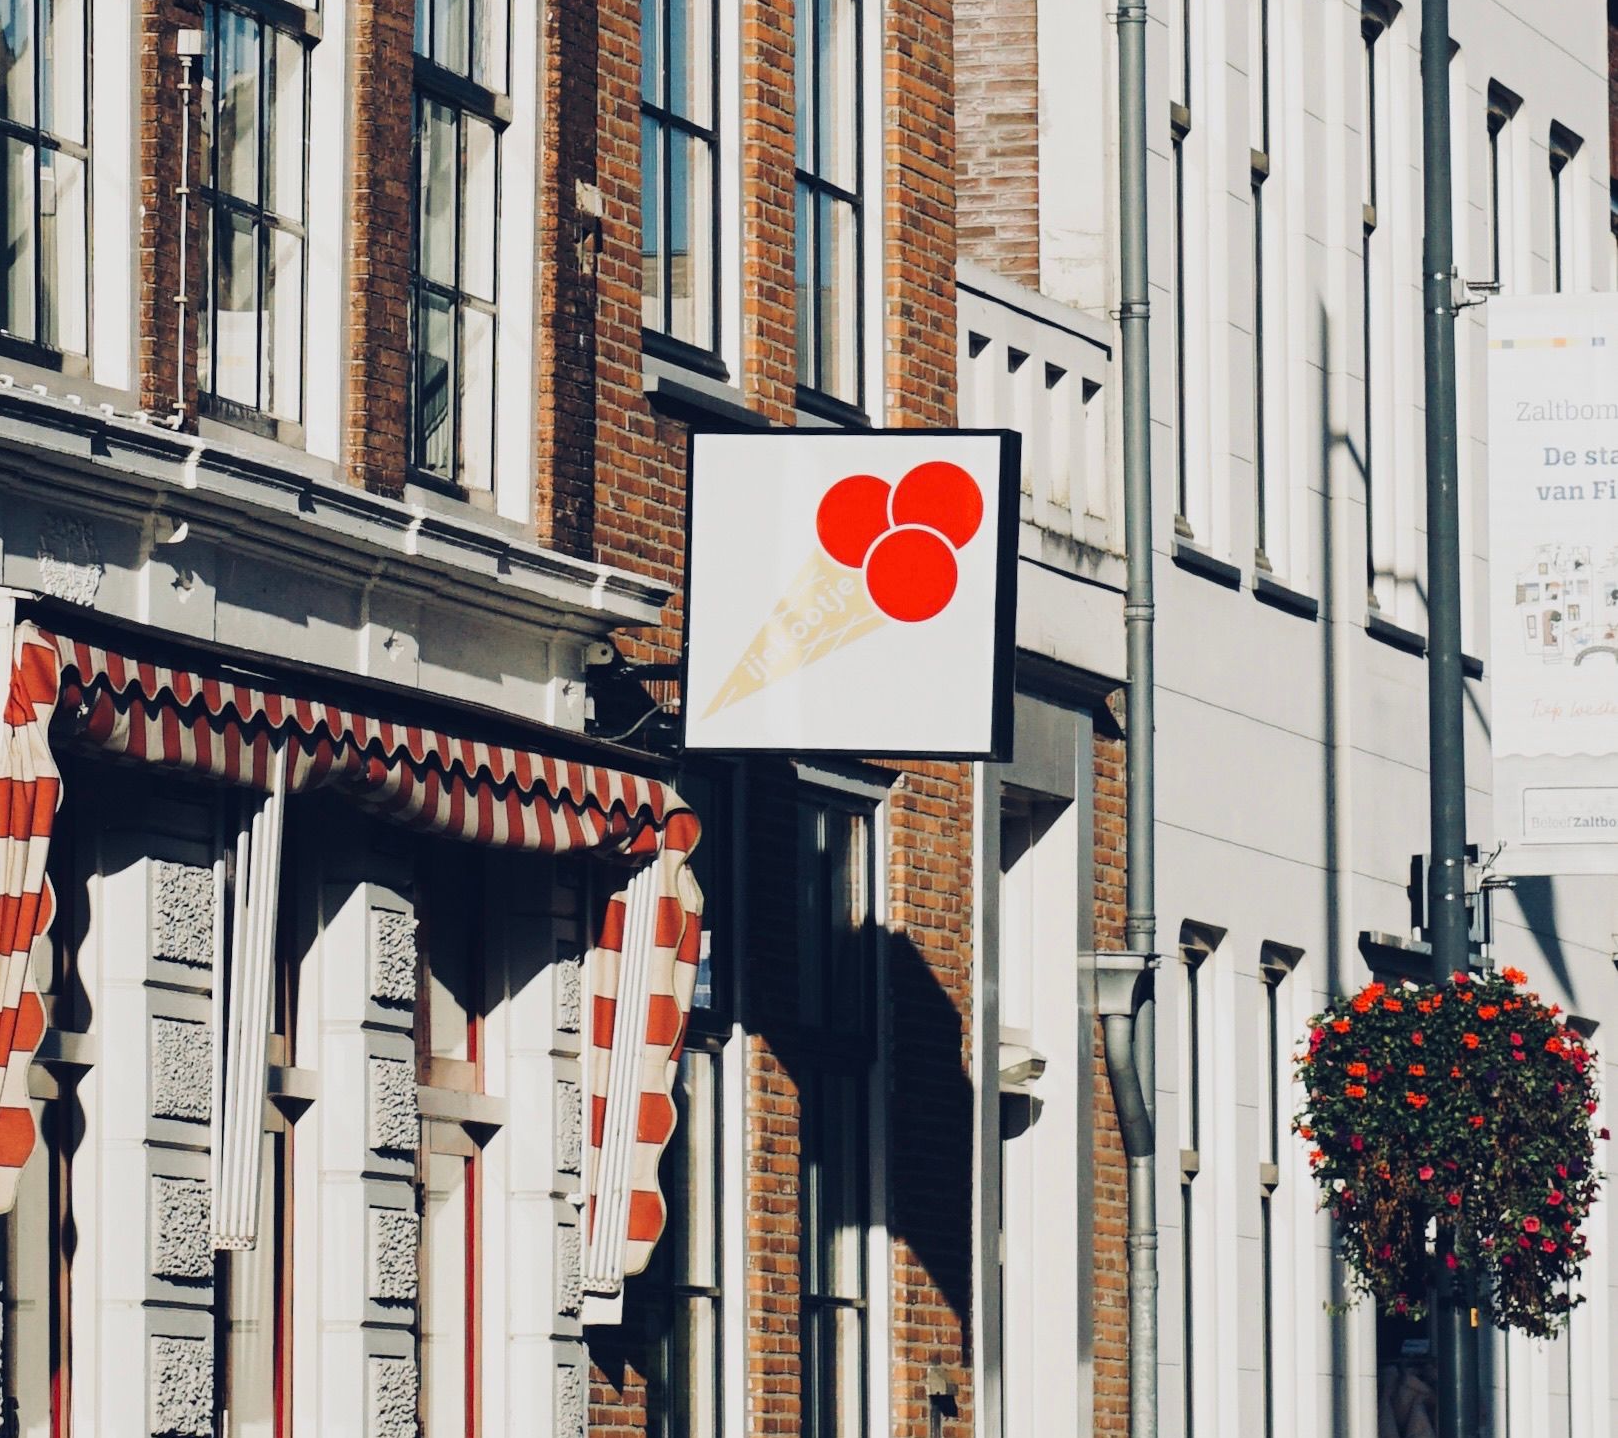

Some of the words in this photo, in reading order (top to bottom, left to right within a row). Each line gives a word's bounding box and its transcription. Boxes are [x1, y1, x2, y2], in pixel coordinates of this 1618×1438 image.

[1516, 399, 1618, 422] Zaltbom
[1543, 447, 1576, 466] De
[1536, 485, 1585, 501] van
[1593, 479, 1617, 500] Fi
